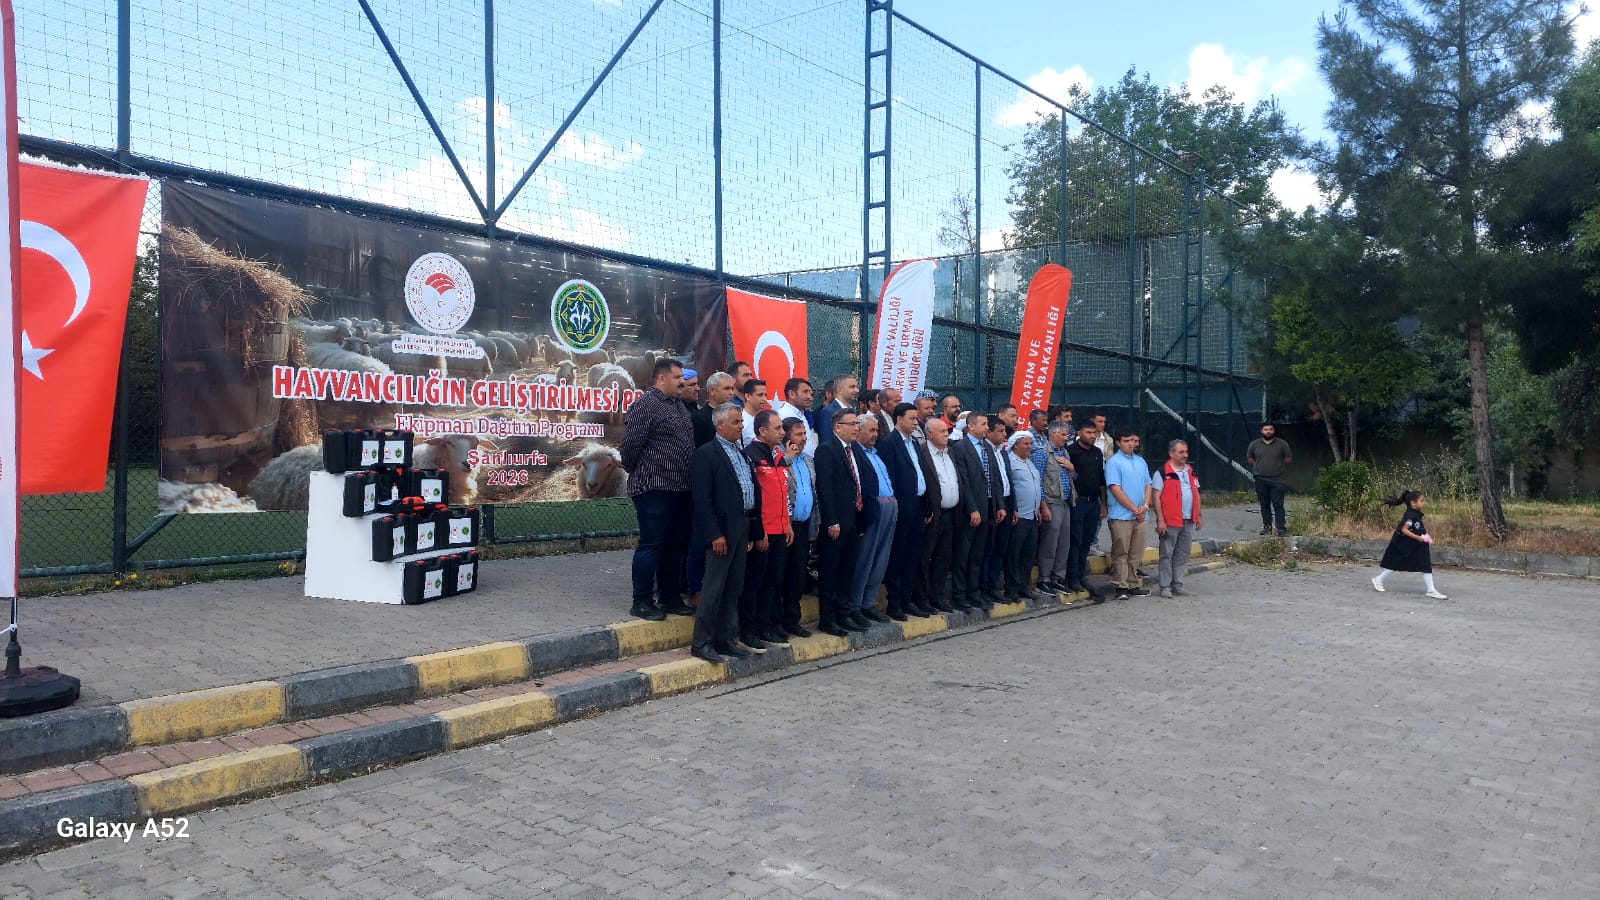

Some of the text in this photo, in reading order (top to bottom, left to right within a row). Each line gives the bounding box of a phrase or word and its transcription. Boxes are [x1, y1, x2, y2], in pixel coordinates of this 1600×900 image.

[900, 309, 914, 348] ORMAN
[1037, 305, 1060, 384] BAKANLIĞI
[898, 350, 908, 364] VE
[908, 328, 925, 392] MÜDÜRLÜĞÜ
[1020, 361, 1036, 407] TARIM
[1028, 338, 1041, 358] VE
[273, 366, 466, 406] HAYVANCILIĞIN
[472, 374, 618, 415] GELİŞTİRİLMESİ
[395, 414, 604, 439] Ekipman Dağıtım Programı
[467, 450, 547, 468] Şanlıurfa
[487, 470, 528, 485] 2026
